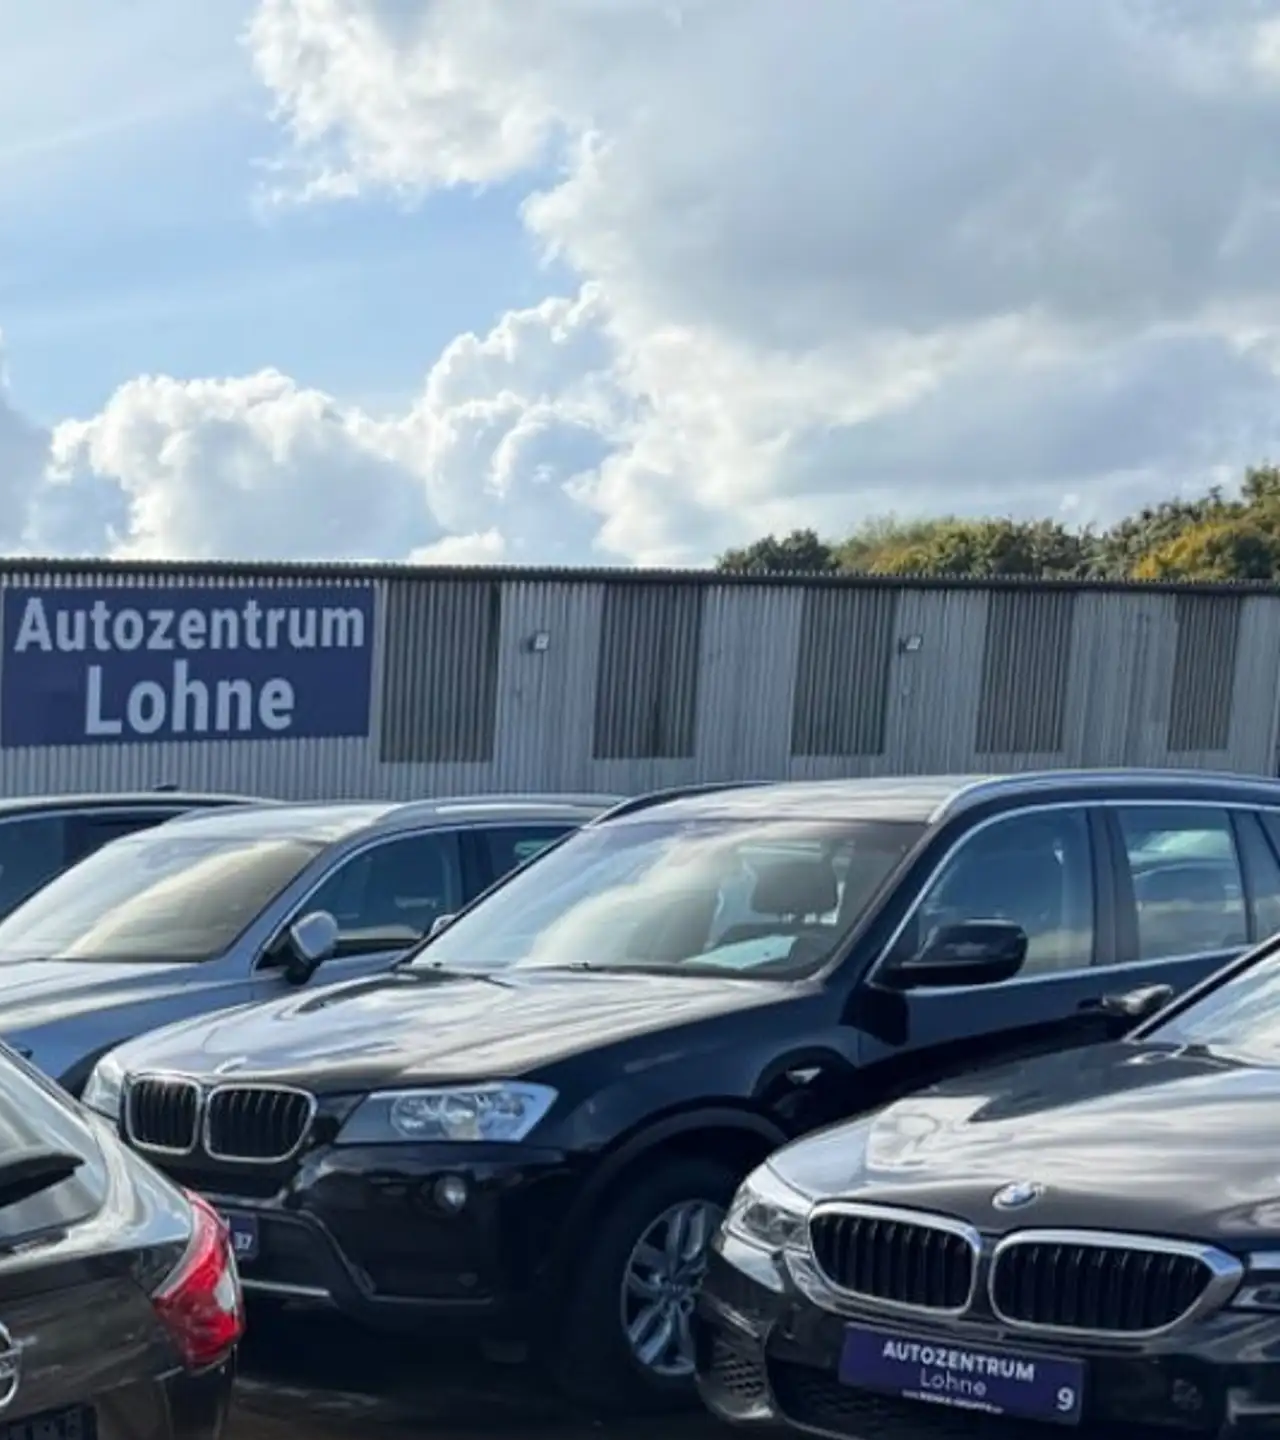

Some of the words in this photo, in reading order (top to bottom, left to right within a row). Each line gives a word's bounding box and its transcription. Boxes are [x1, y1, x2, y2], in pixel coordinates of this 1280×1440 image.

[14, 597, 365, 652] Autozentrum
[85, 659, 295, 735] Lohne
[883, 1340, 1035, 1382] AUTOZENTRUM
[920, 1367, 987, 1397] Lohne
[1056, 1387, 1075, 1411] 9
